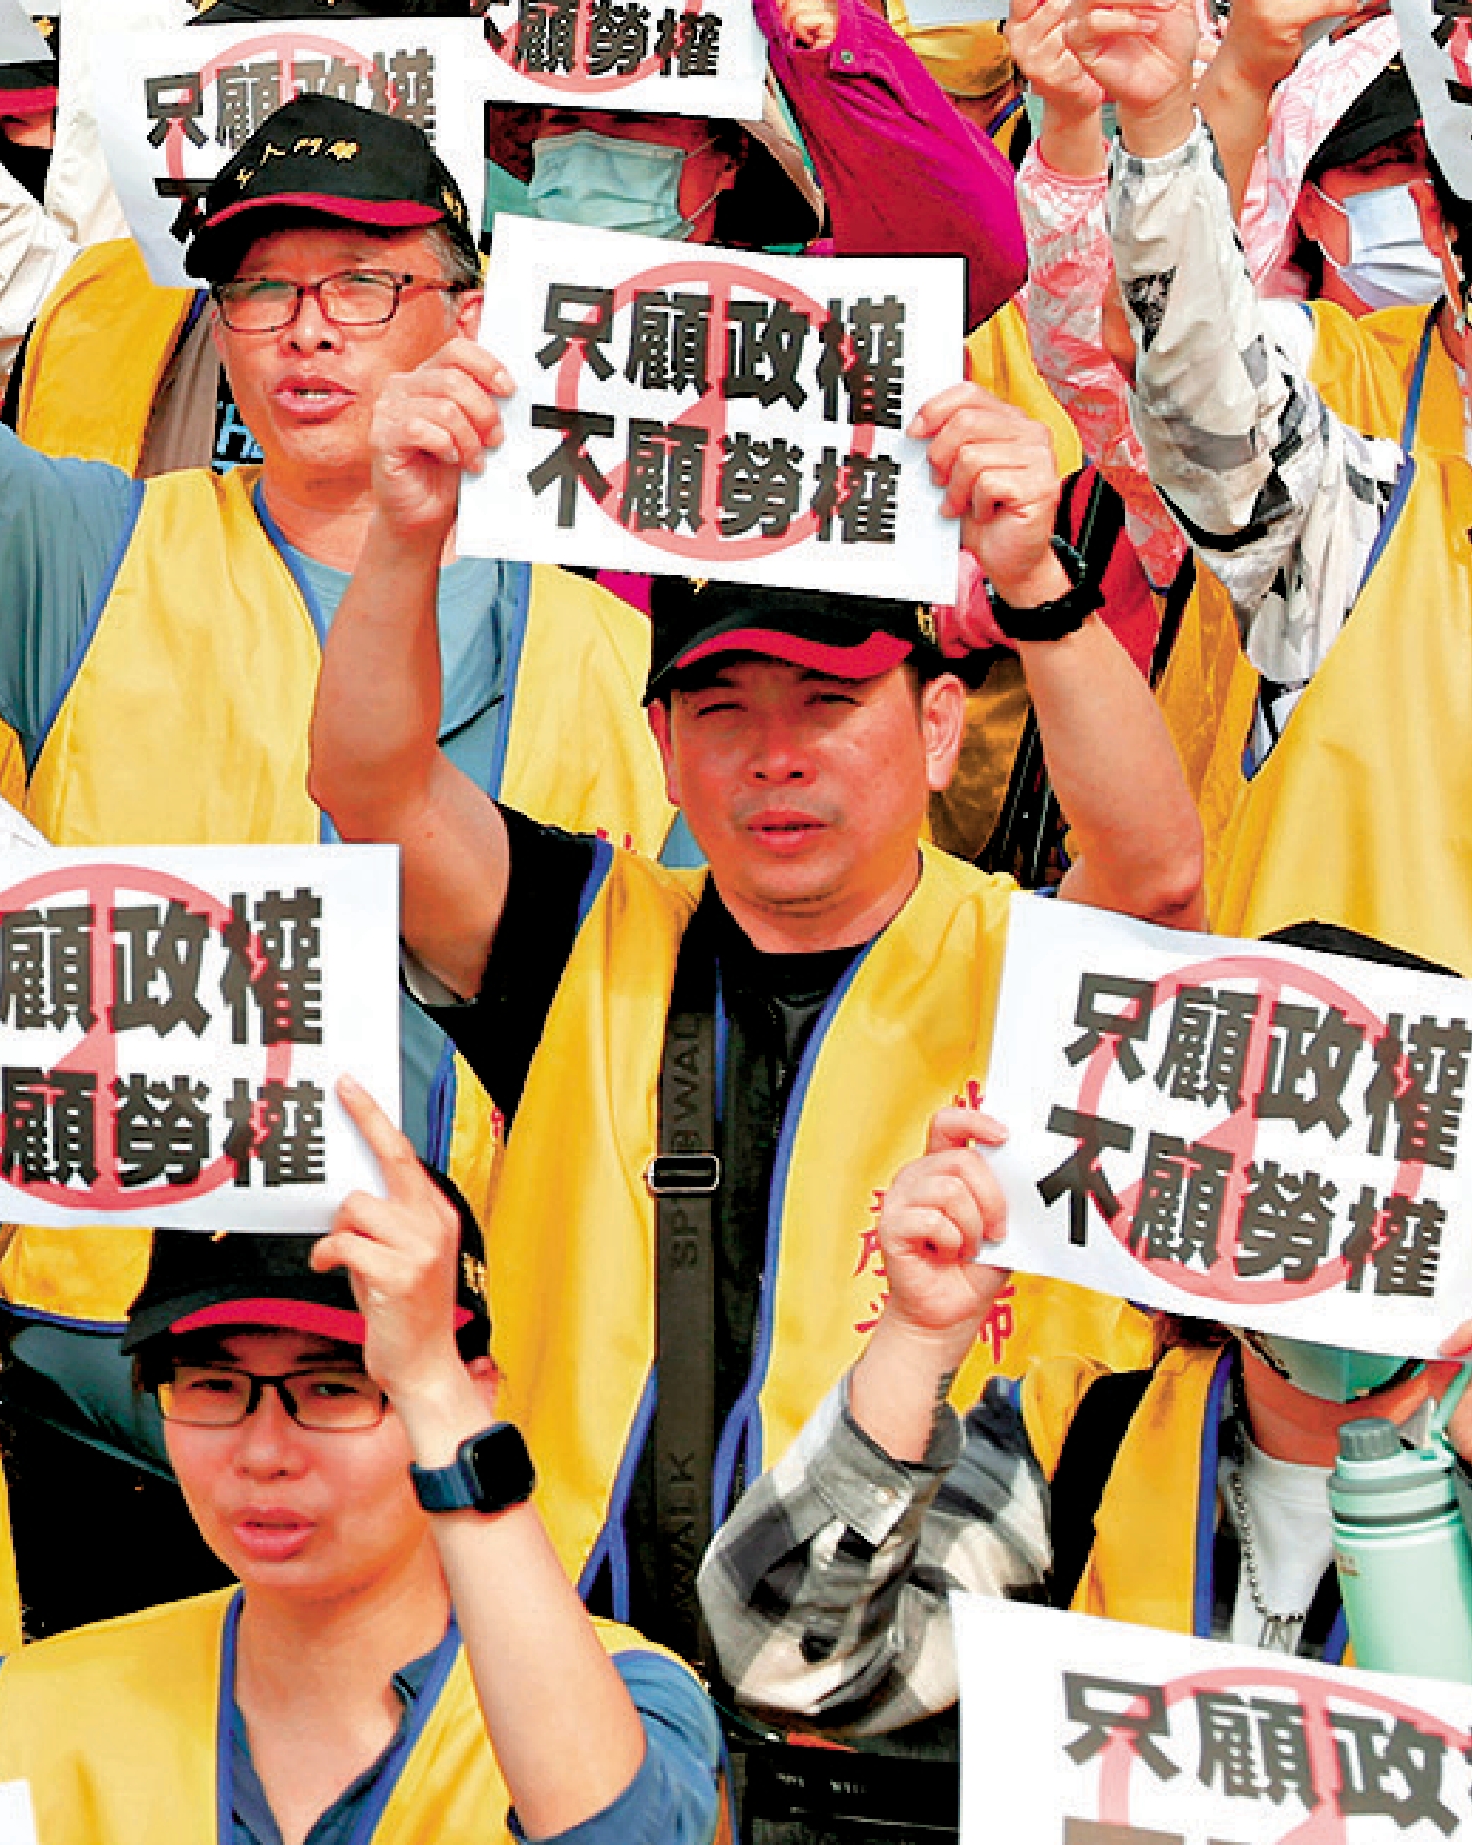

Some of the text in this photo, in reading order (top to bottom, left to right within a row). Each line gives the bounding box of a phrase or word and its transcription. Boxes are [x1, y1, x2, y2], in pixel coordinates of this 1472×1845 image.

[534, 282, 906, 431] 只顧政權
[527, 405, 902, 545] 不顧勞權
[1063, 971, 1472, 1170] 只顧政權
[1036, 1102, 1449, 1299] 不顧勞權
[1062, 1671, 1472, 1835] 只顧政
